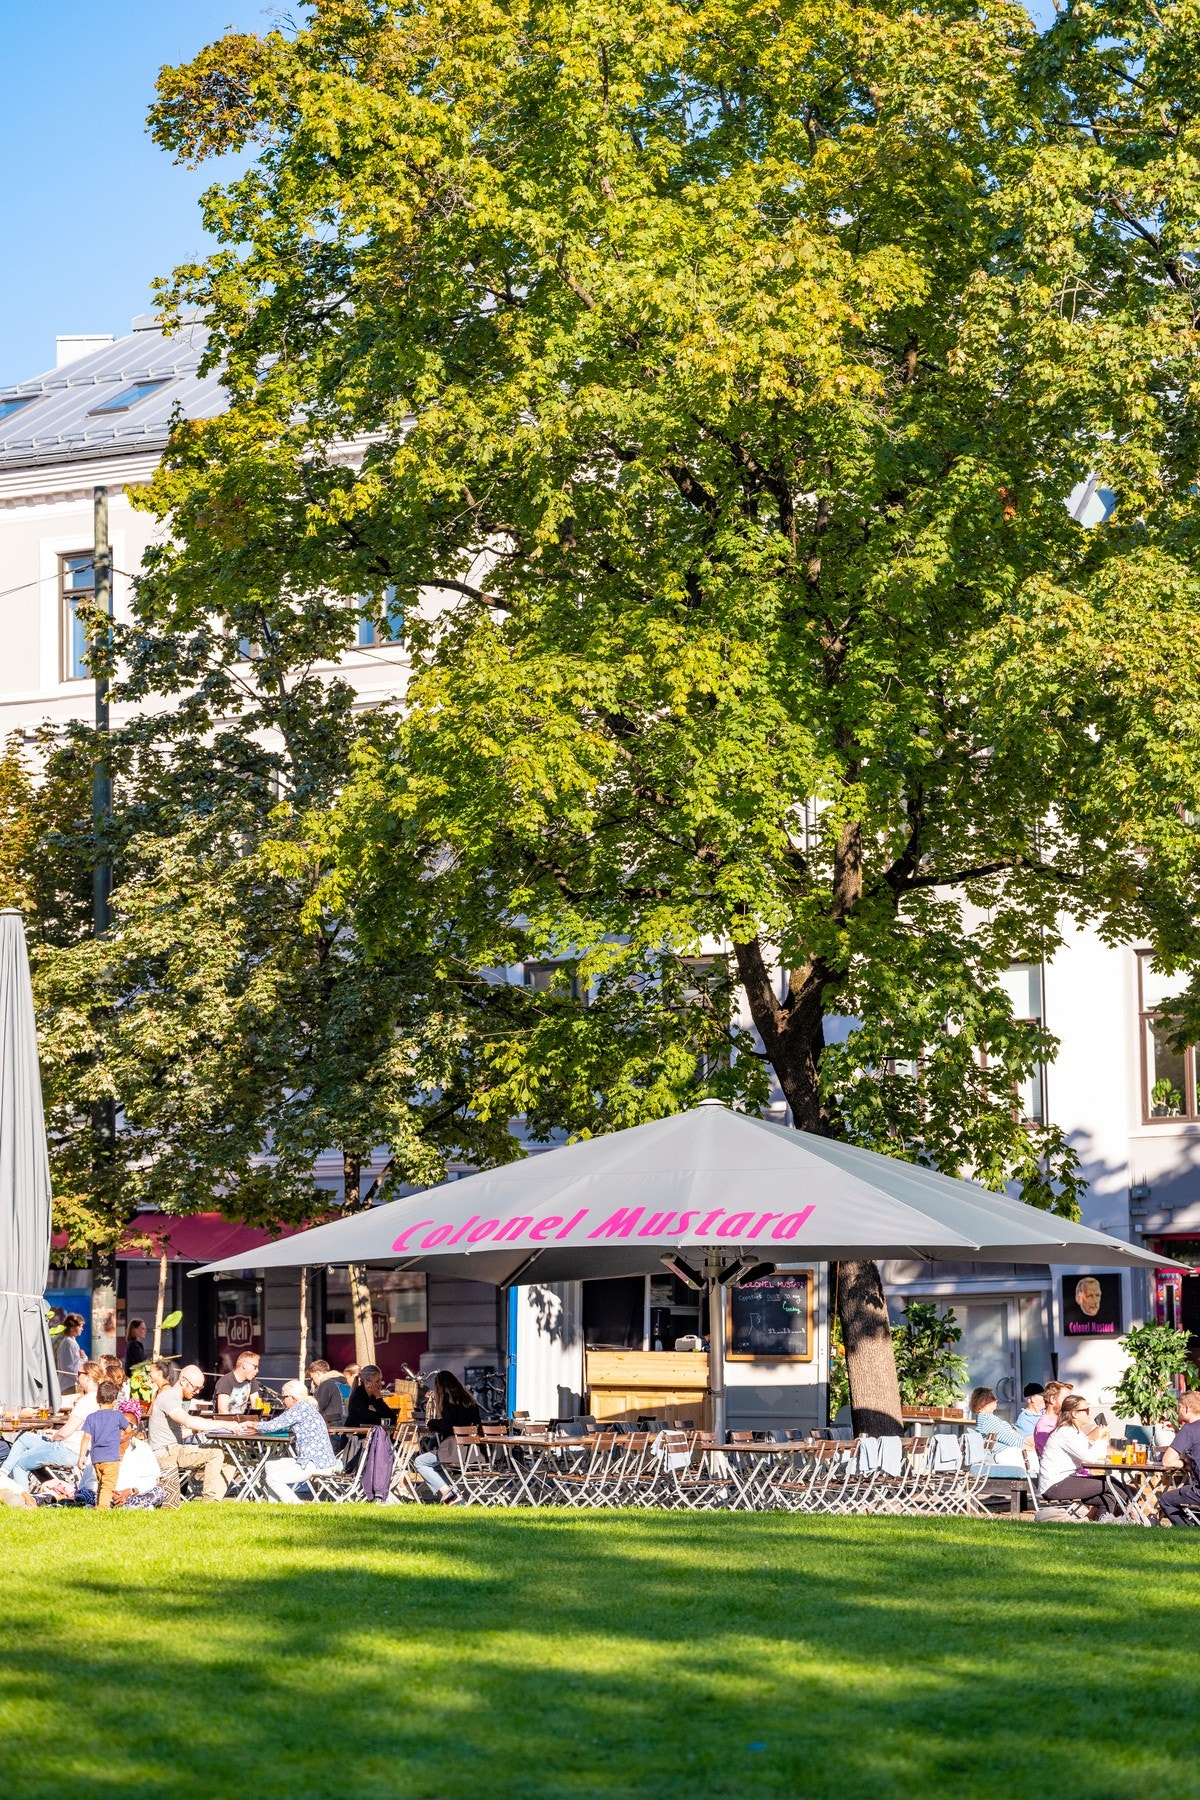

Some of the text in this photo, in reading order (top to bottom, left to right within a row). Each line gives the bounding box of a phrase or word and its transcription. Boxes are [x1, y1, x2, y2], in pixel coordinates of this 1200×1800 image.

[391, 1205, 816, 1252] Colonel Mustard
[231, 1319, 248, 1340] deli
[374, 1319, 384, 1338] eli
[1069, 1321, 1114, 1333] Colonel Mustard
